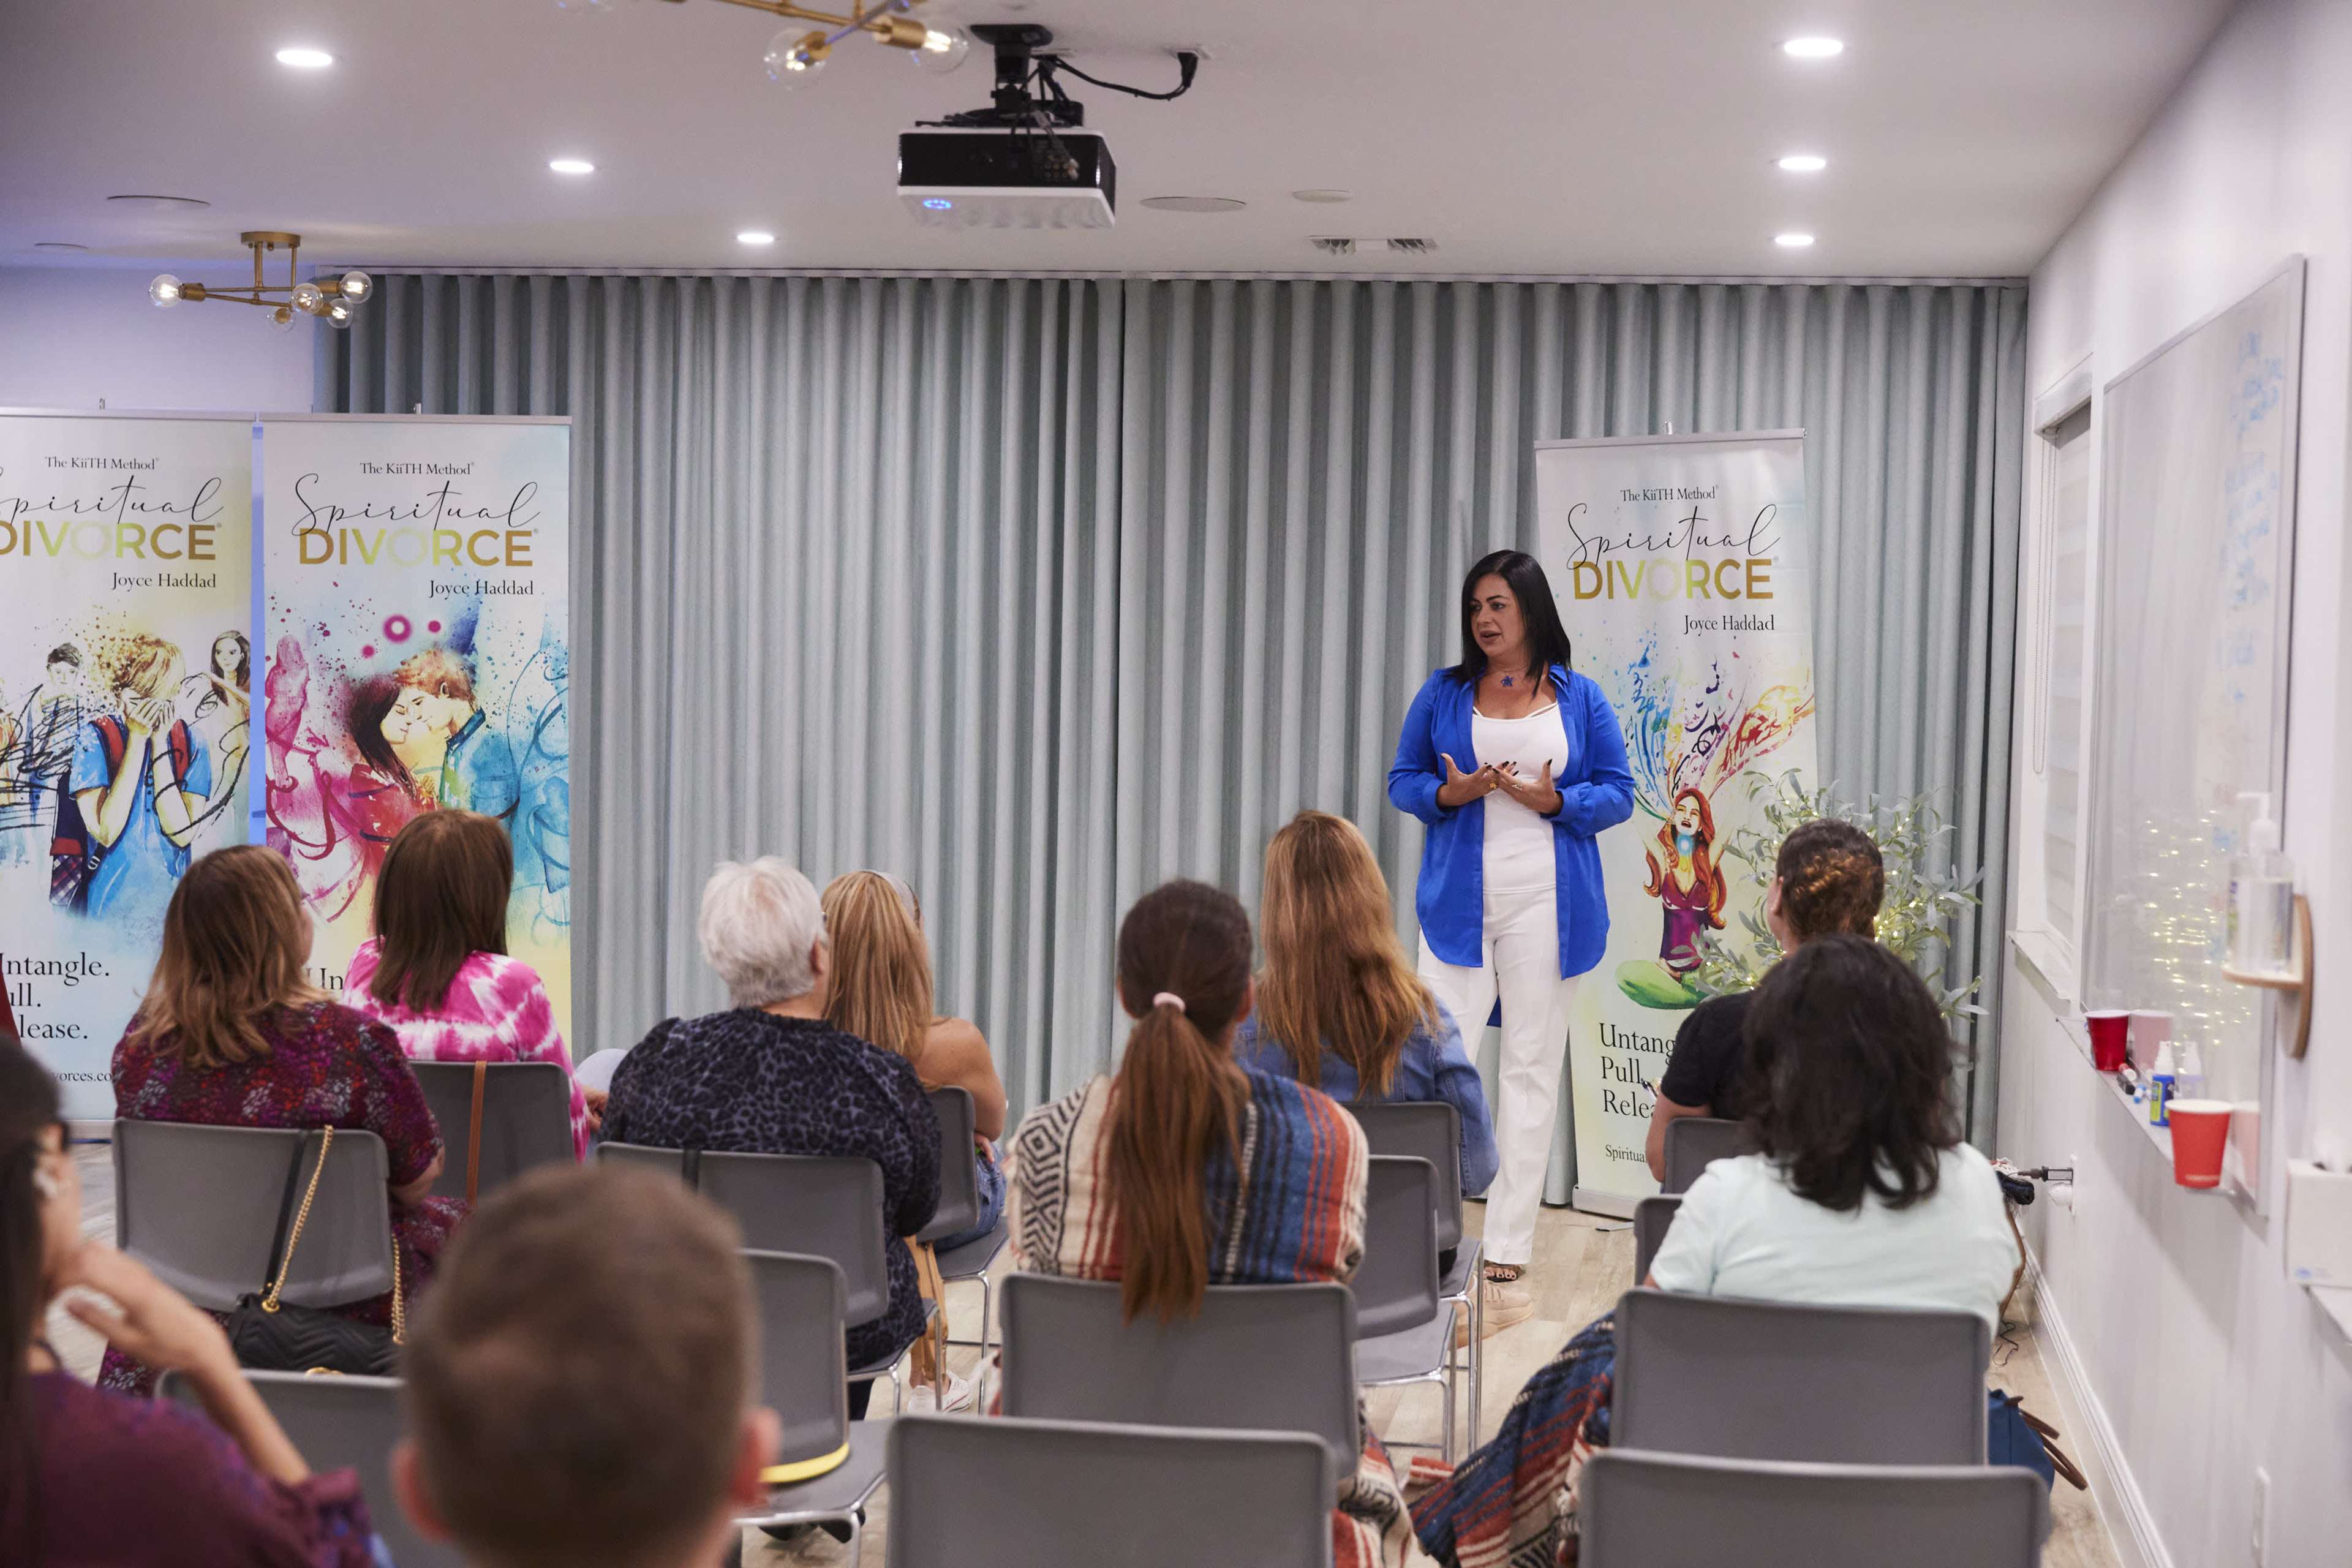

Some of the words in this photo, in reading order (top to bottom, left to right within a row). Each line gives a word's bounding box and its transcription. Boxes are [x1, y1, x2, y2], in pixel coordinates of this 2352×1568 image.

[45, 456, 67, 467] The
[71, 458, 107, 469] KiiTH
[360, 462, 383, 473] The
[386, 463, 421, 474] KiiTH
[0, 467, 224, 525] piritual
[292, 473, 541, 537] Spiritual
[1620, 489, 1640, 501] The
[1643, 488, 1673, 500] KiiTH
[1567, 503, 1781, 570] Spiritual
[111, 572, 153, 592] Joyce
[158, 573, 216, 588] Haddad
[429, 581, 470, 600] Joyce
[475, 581, 533, 596] Haddad
[1684, 615, 1717, 636] Joyce
[1722, 615, 1774, 631] Haddad
[0, 952, 110, 986] ntangle.
[19, 1014, 88, 1039] lease.
[1598, 1022, 1676, 1066] Untang
[1601, 1056, 1642, 1084] Pull
[1602, 1089, 1656, 1119] Rele
[1605, 1144, 1646, 1163] Spiritua
